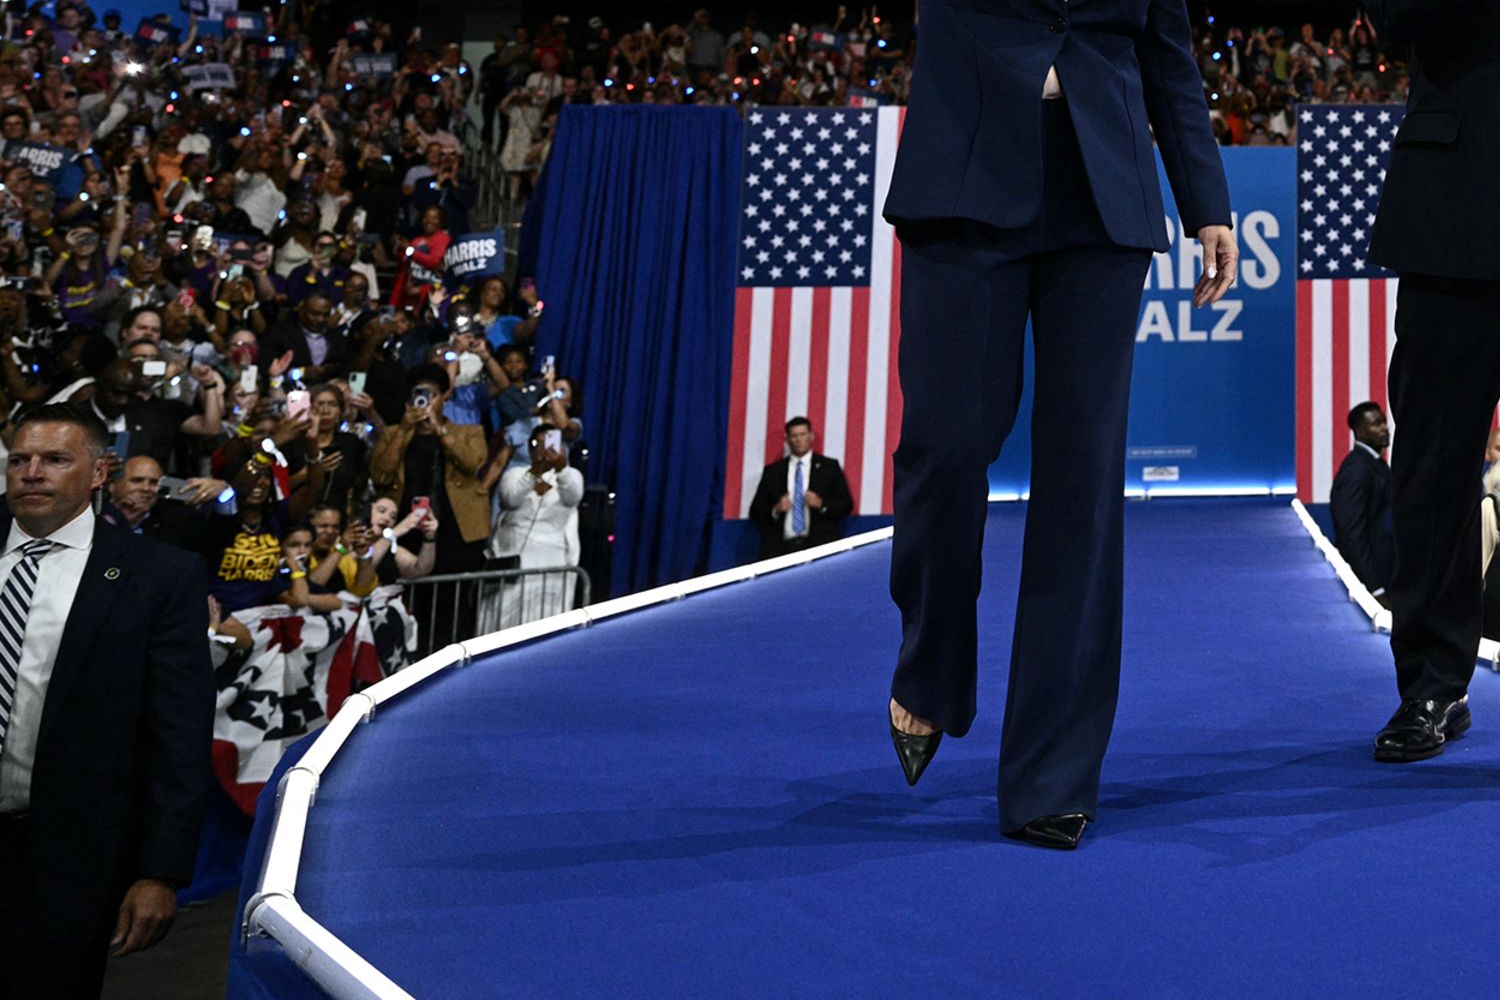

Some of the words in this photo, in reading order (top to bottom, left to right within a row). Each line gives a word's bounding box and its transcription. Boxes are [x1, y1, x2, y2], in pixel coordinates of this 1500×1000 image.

[443, 239, 497, 268] HARRIS
[452, 257, 487, 277] WALZ
[1136, 300, 1244, 343] ALZ
